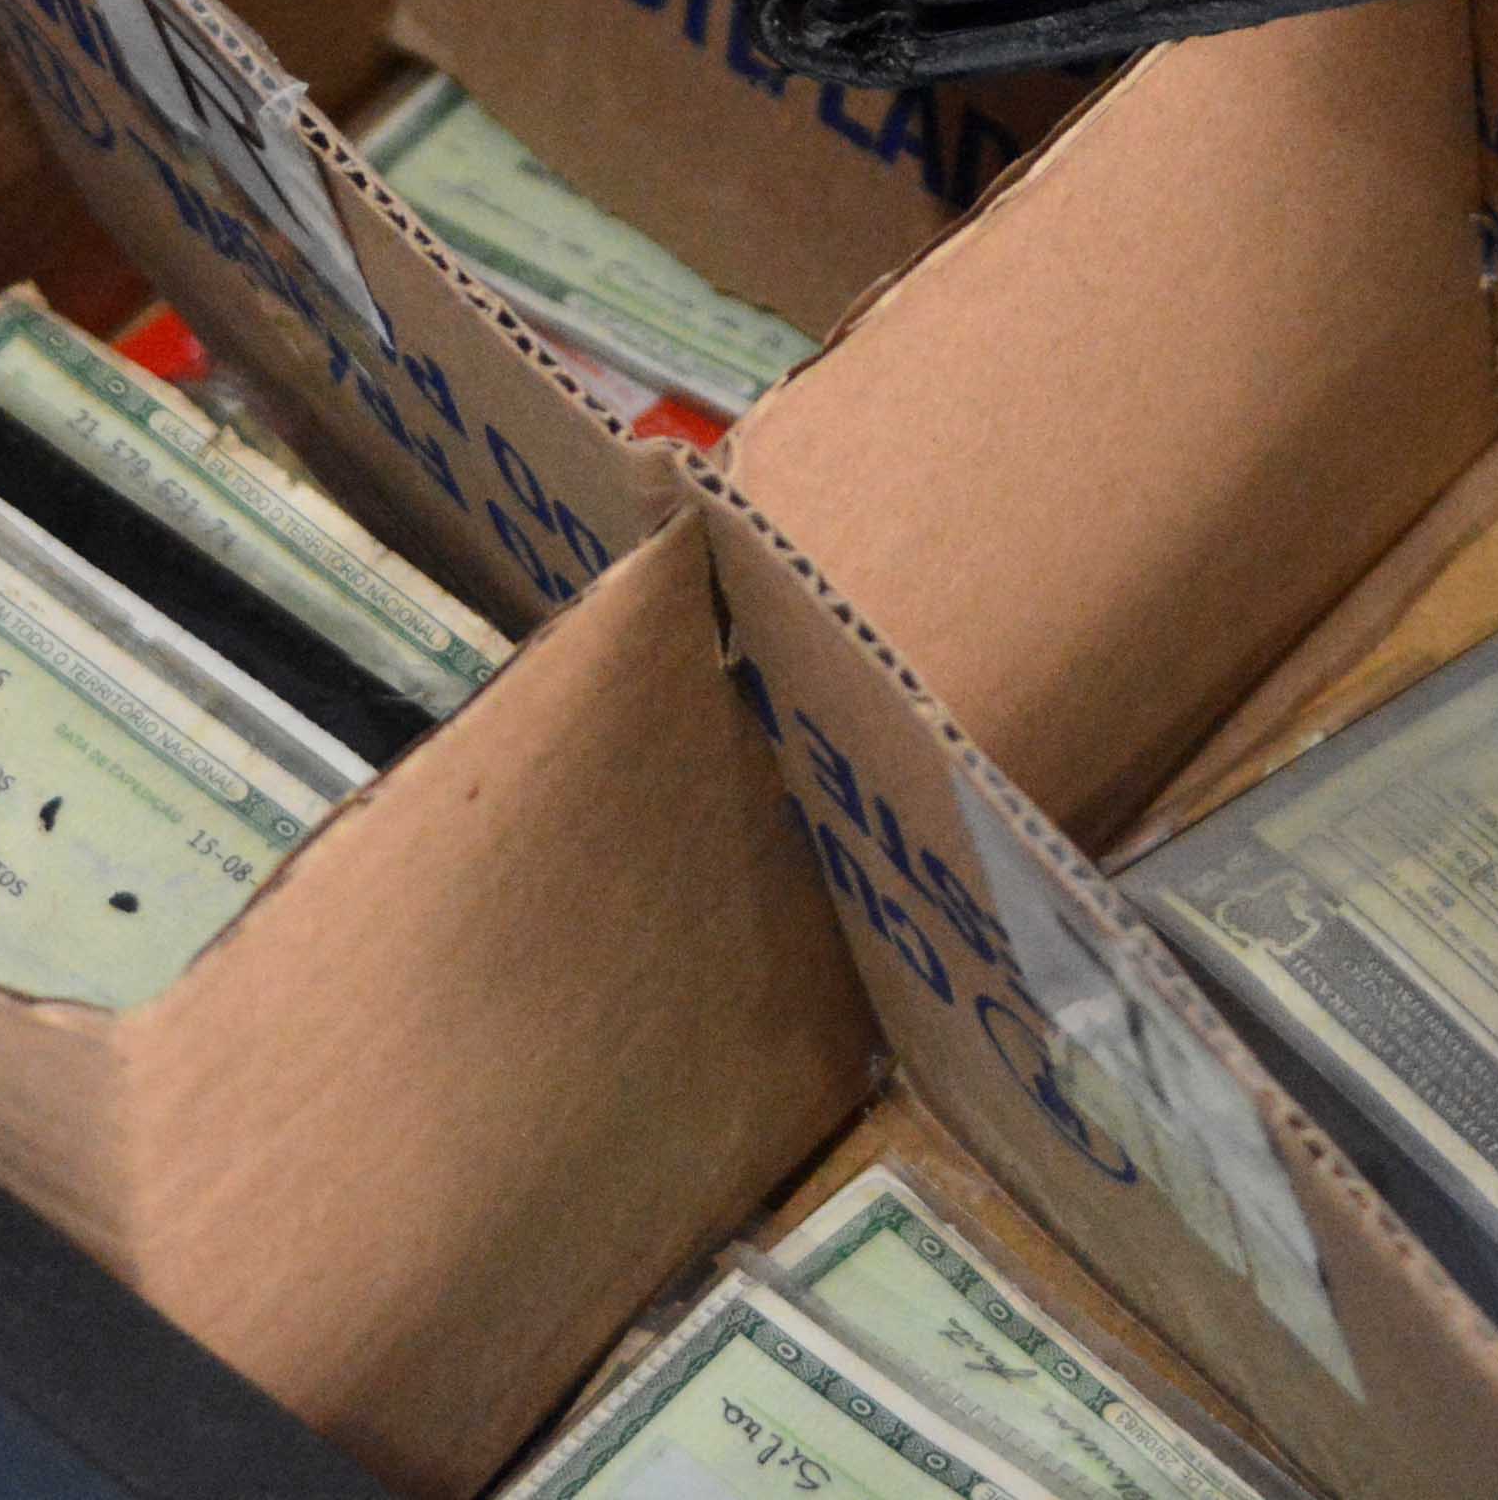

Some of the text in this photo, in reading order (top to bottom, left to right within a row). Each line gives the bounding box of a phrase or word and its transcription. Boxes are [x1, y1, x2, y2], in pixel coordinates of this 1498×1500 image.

[361, 578, 444, 646] NACIONAL
[8, 616, 57, 657] TODO
[64, 656, 165, 739] TERRITÓRIO
[155, 728, 238, 796] NACIONAL
